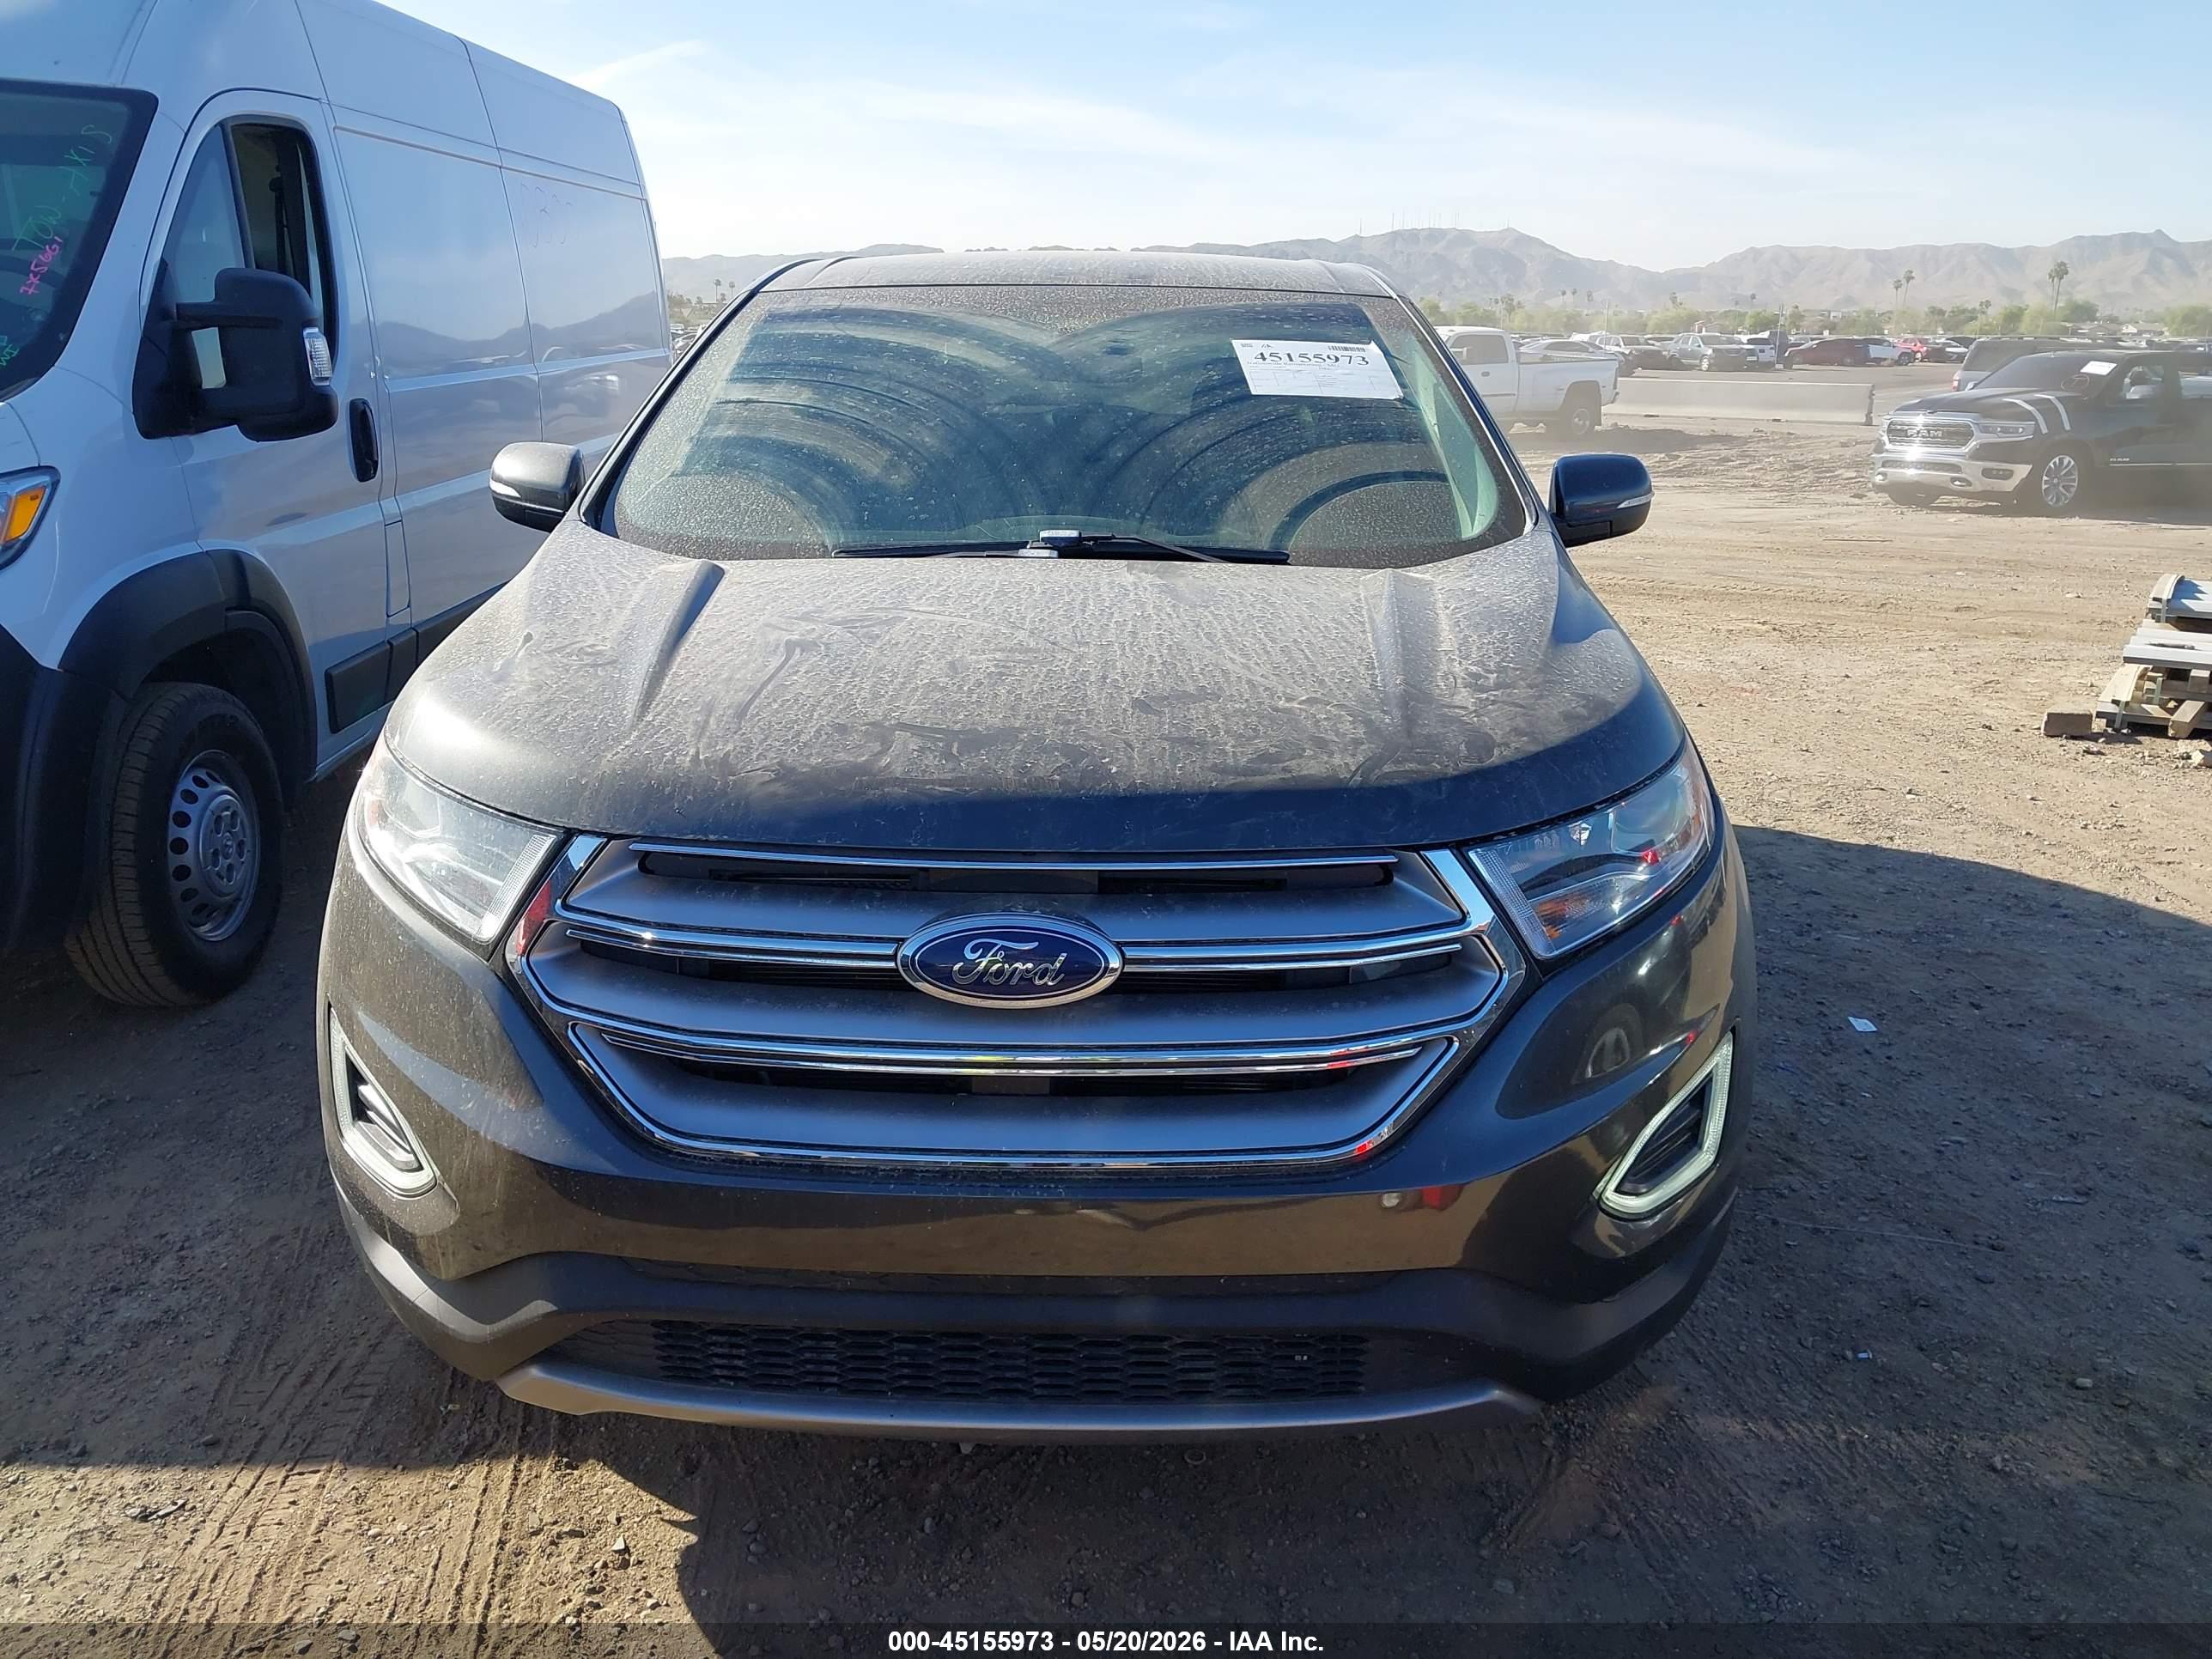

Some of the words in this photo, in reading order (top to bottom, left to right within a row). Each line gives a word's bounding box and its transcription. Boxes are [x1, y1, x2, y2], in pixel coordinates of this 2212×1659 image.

[1254, 351, 1370, 366] 45155973
[1906, 428, 1943, 438] RAM
[951, 938, 1066, 986] Ford
